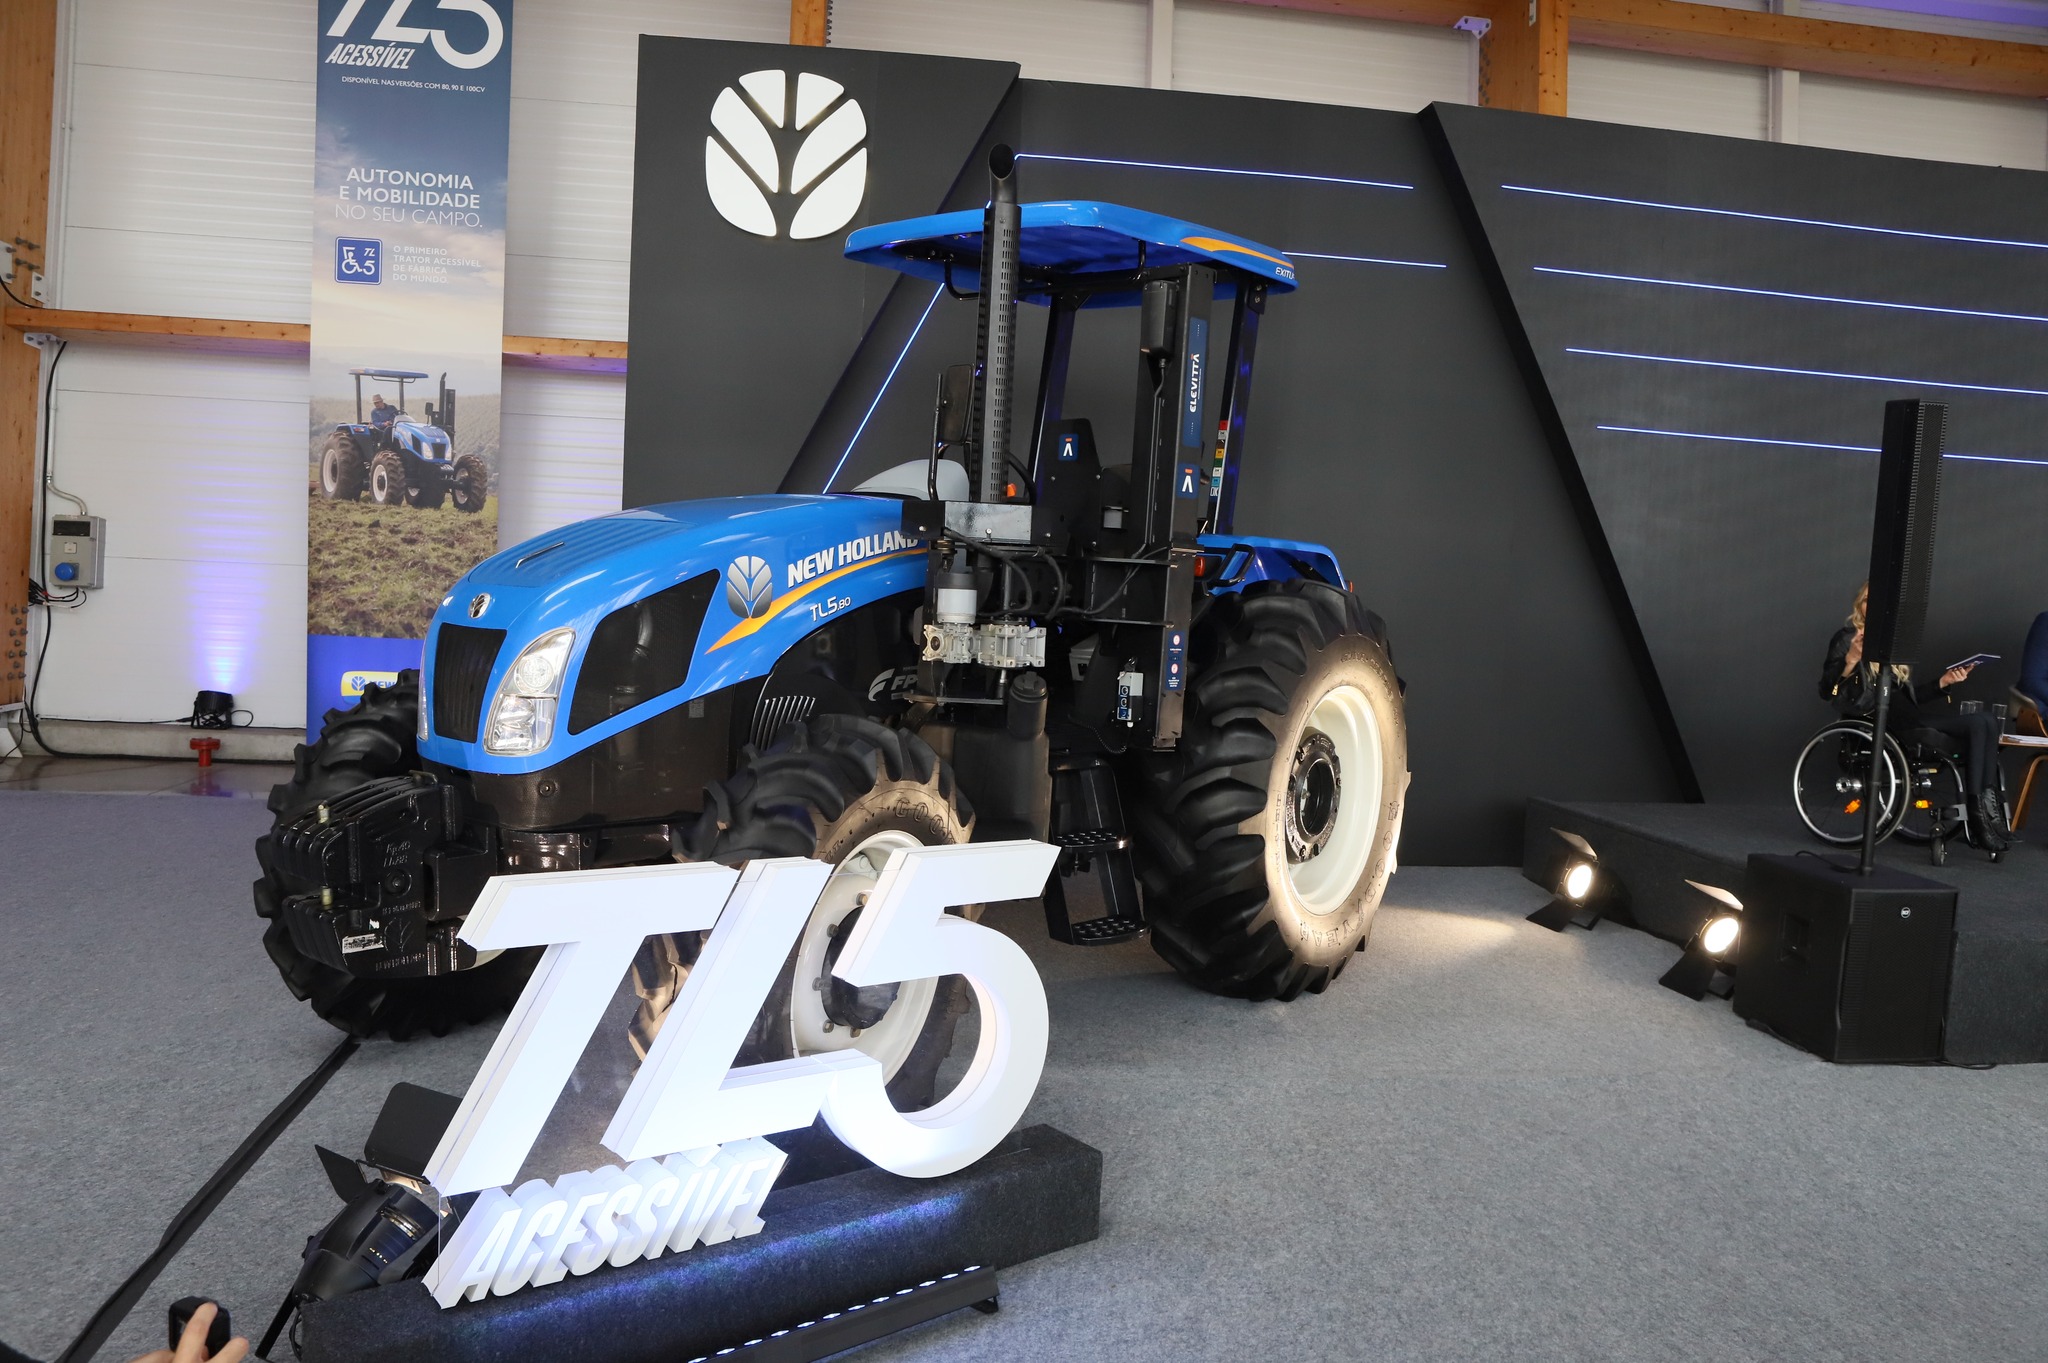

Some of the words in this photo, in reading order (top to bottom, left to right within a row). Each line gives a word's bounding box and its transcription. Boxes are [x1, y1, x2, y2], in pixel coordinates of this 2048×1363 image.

[325, 42, 416, 69] ACESSÍVEL
[341, 75, 379, 85] DISPONÍVEL
[394, 80, 423, 89] VERSÕES
[424, 82, 441, 90] COM
[466, 85, 485, 93] 100CV
[346, 167, 474, 190] AUTONOMIA
[339, 185, 350, 200] E
[357, 187, 480, 209] MOBILIDADE
[335, 203, 366, 220] NO
[372, 206, 405, 222] SEU
[412, 209, 483, 228] CAMPO.
[393, 245, 401, 253] O
[404, 246, 448, 256] PRIMEIRO
[393, 255, 431, 264] TRATOR
[433, 257, 481, 268] ACESSÍVEL
[392, 273, 408, 281] DO
[393, 264, 405, 272] DE
[408, 263, 448, 274] FÁBRICA
[787, 547, 835, 588] NEW
[810, 596, 851, 622] TL5.80
[891, 674, 918, 690] FP
[422, 839, 1060, 1199] TL5
